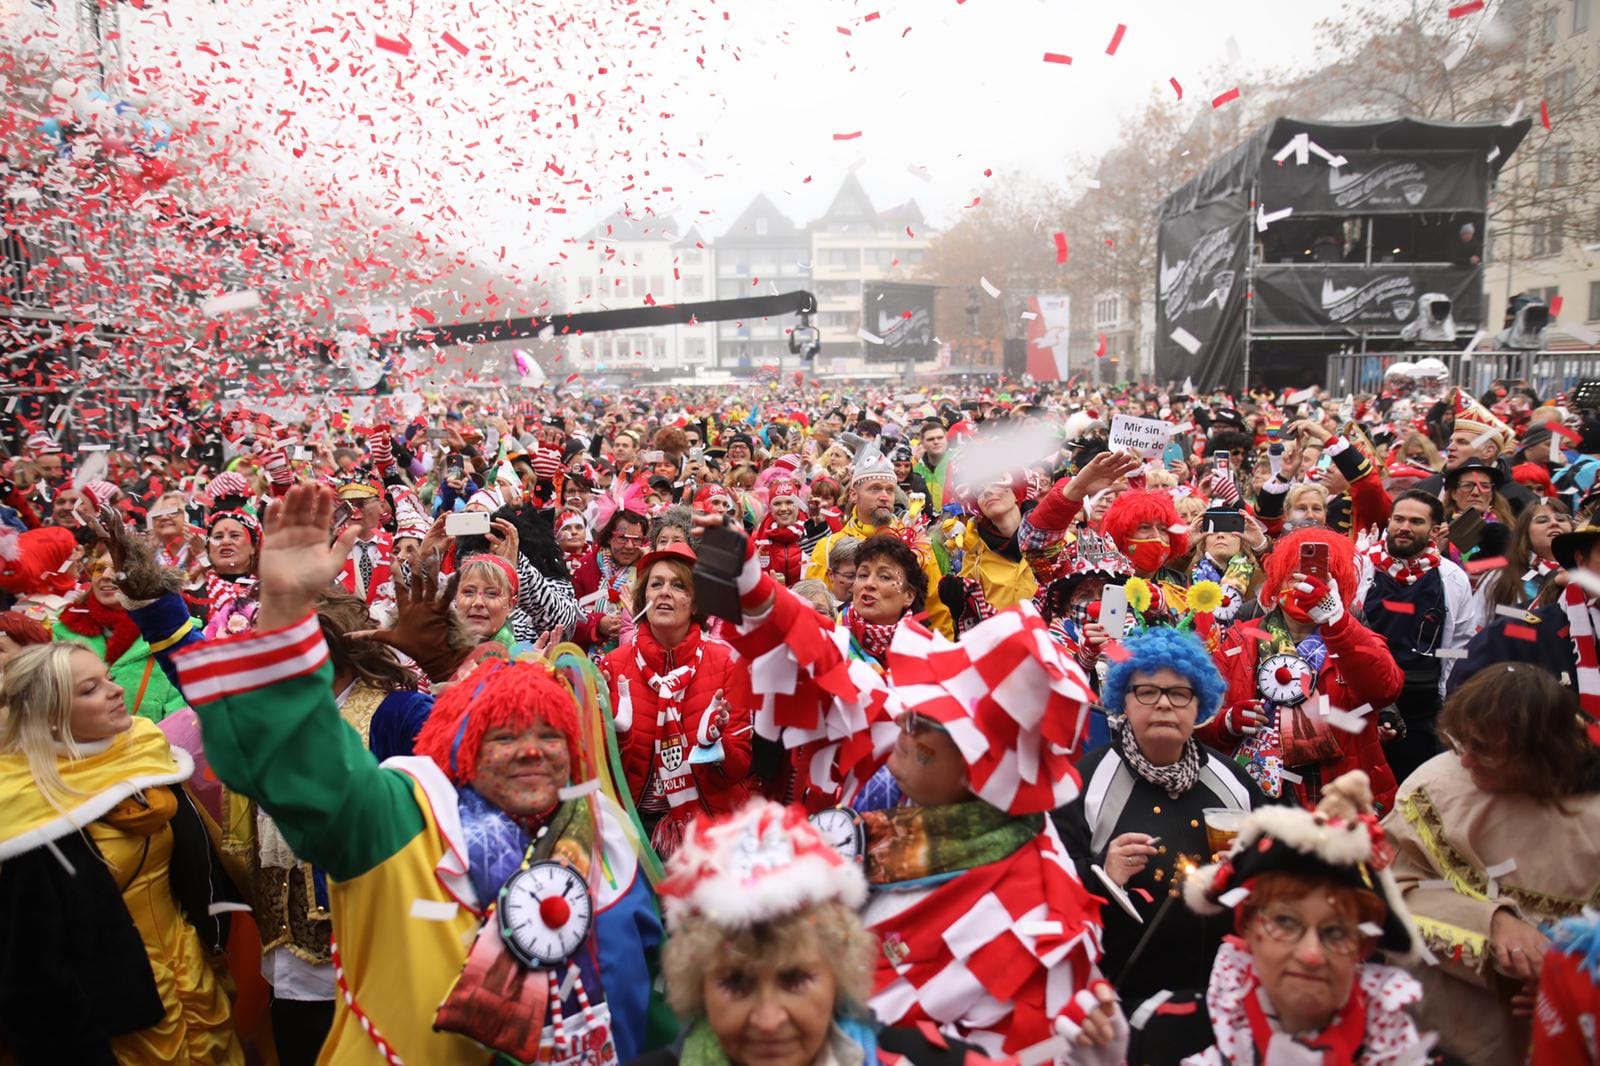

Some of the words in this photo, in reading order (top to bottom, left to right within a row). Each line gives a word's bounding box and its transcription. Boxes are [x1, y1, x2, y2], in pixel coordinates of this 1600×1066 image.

[1124, 422, 1142, 432] Mir
[1145, 425, 1159, 435] sin
[1114, 437, 1149, 449] widder
